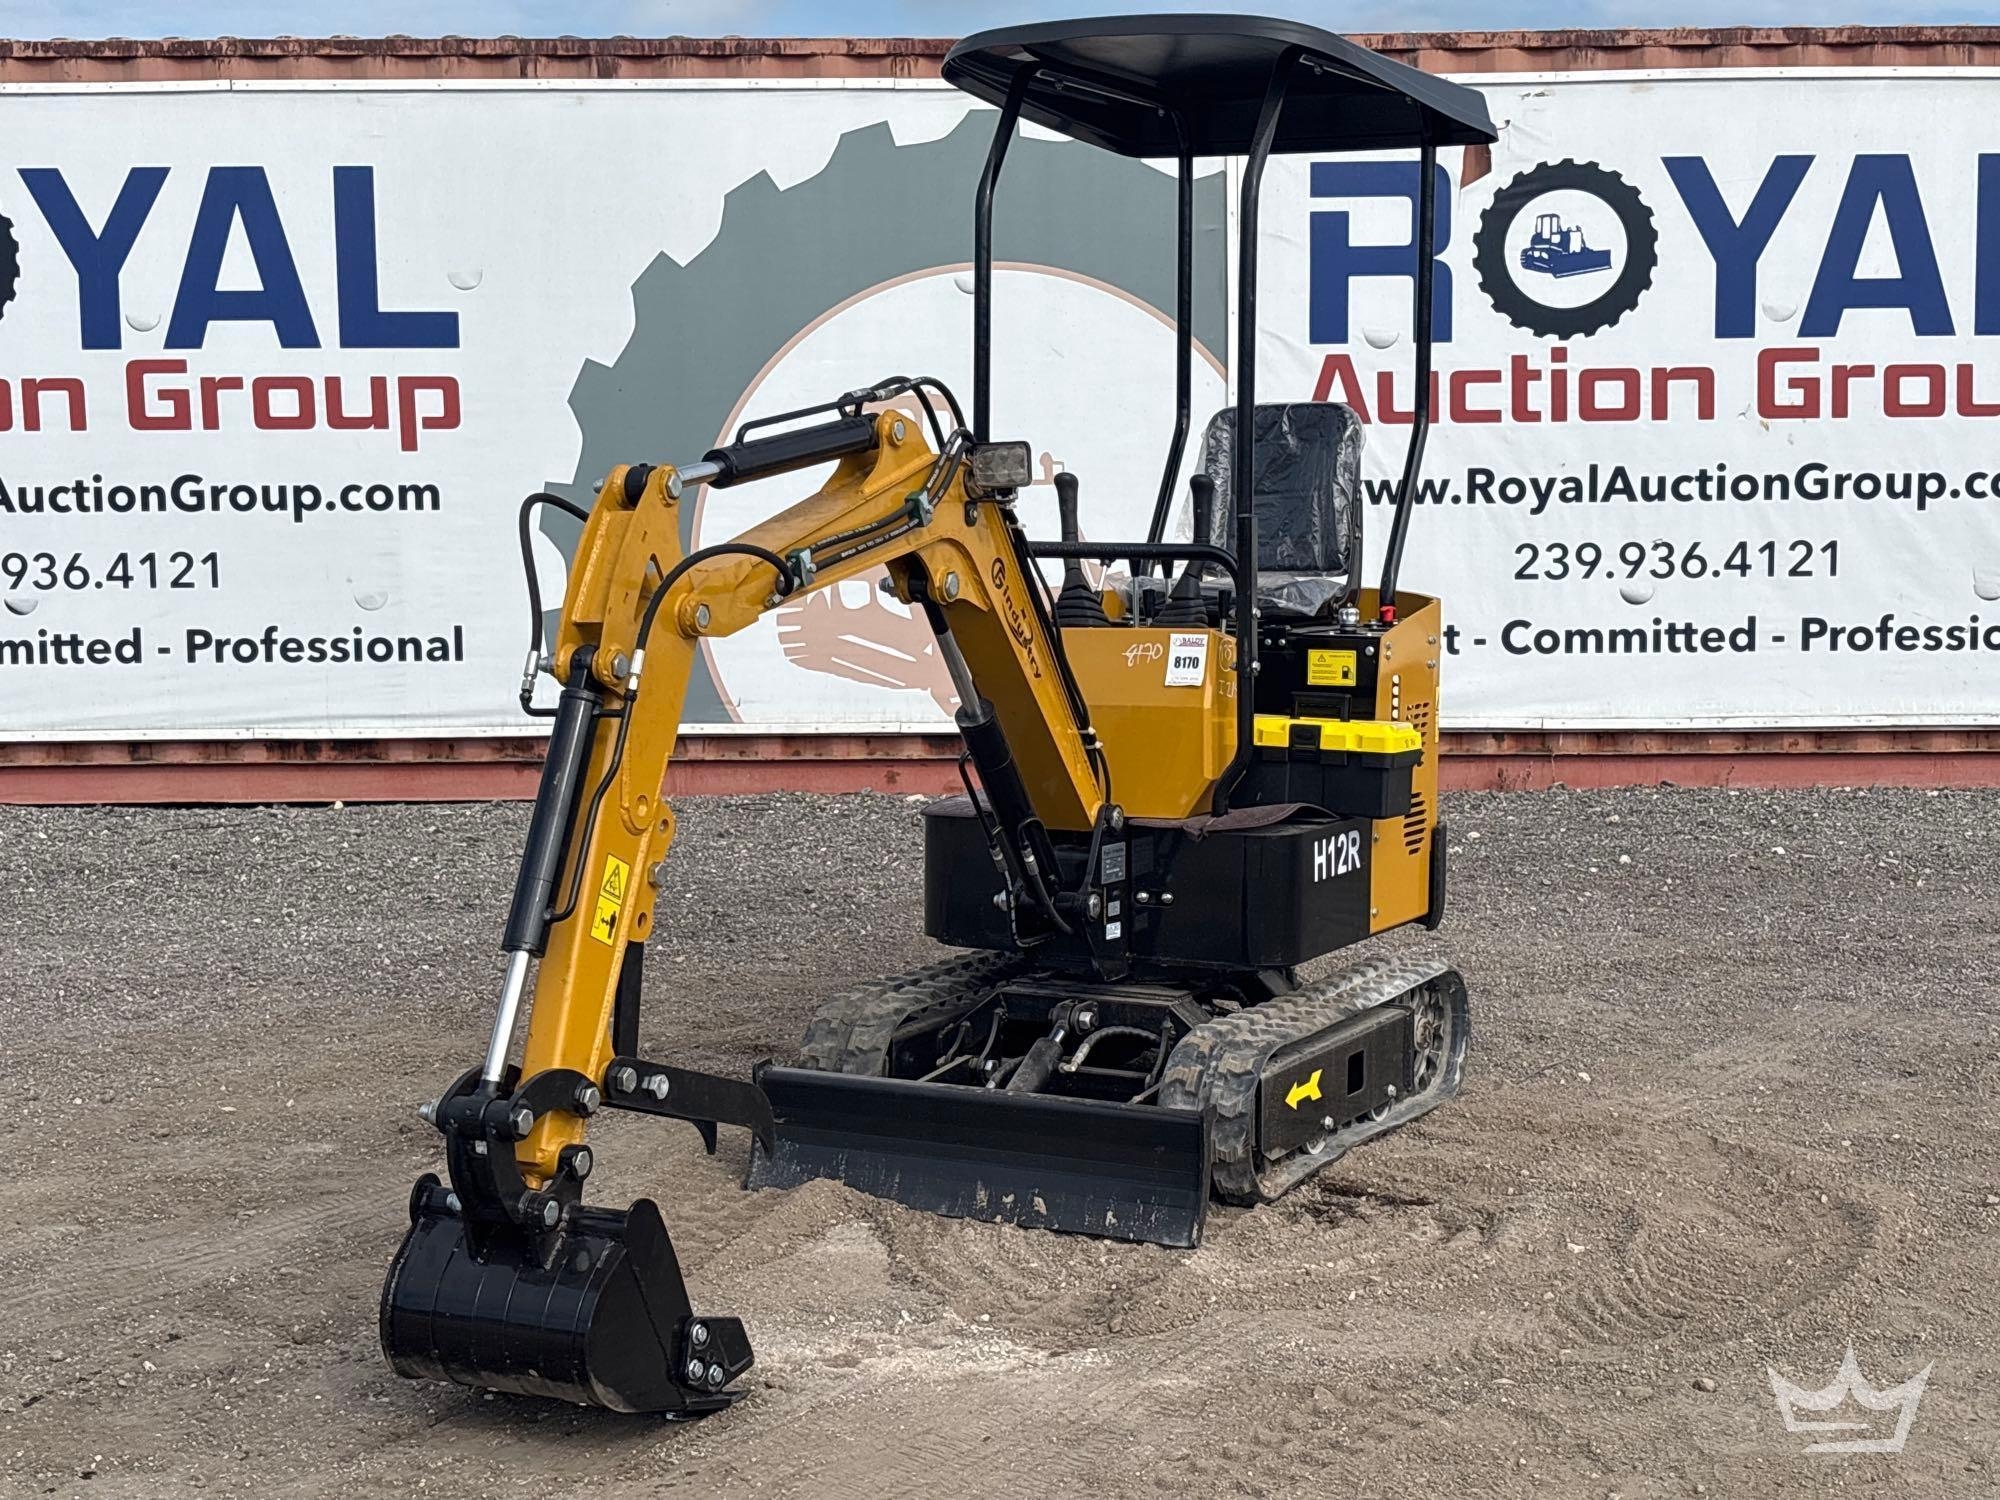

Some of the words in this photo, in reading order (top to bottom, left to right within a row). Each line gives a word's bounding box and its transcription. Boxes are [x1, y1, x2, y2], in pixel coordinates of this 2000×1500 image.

[0, 166, 460, 350] YAL
[0, 377, 88, 432] n
[125, 358, 461, 452] Group
[1311, 347, 1715, 425] Auction
[1361, 462, 2000, 516] ww.RoyalAuctionGroup.c
[1, 551, 220, 591] 936.4121
[1513, 539, 1838, 581] 239.936.4121
[185, 625, 463, 664] Professional
[1501, 615, 1757, 655] Committed
[1174, 656, 1200, 669] 8170
[1314, 829, 1361, 883] H12R
